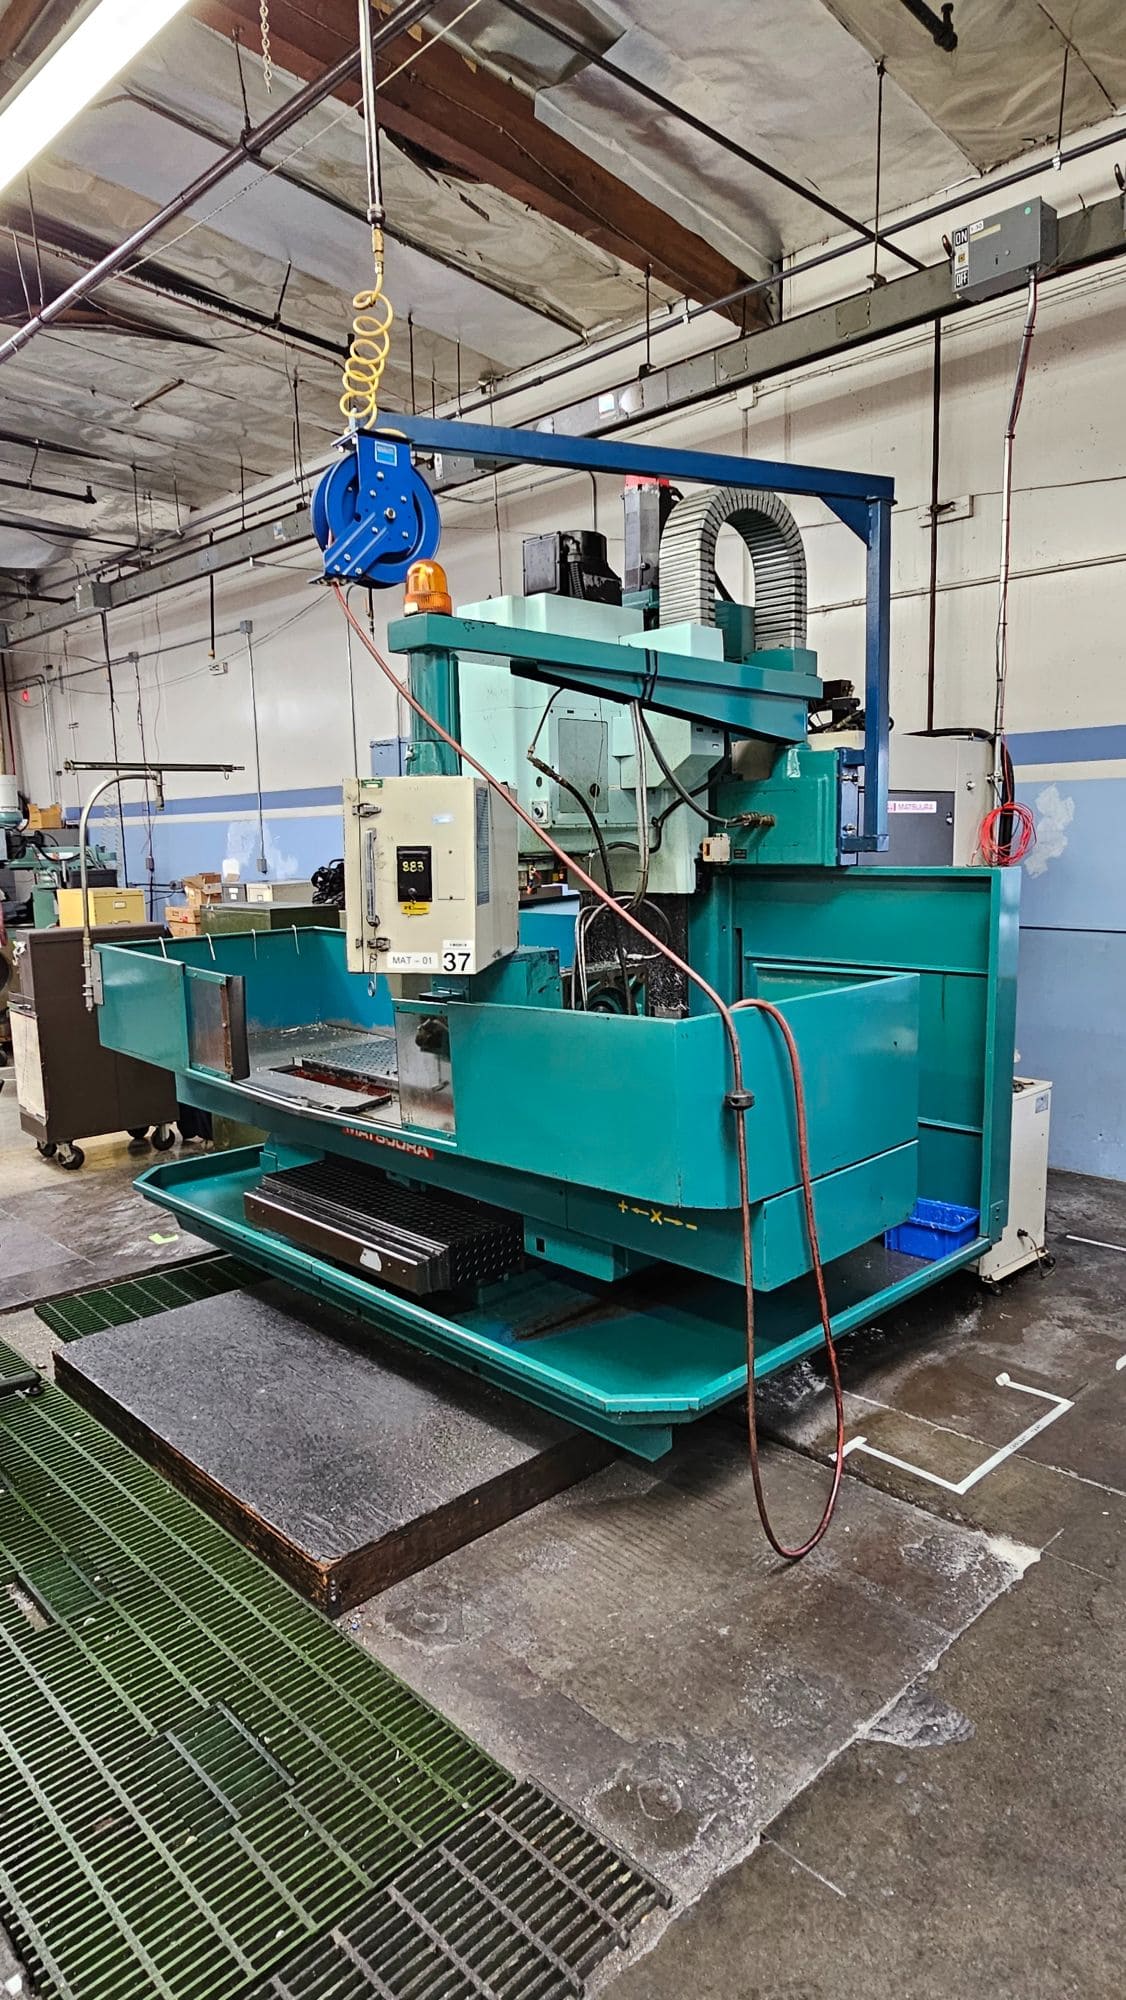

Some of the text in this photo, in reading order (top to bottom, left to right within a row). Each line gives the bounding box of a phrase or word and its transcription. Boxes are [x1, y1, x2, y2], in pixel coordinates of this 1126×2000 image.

[955, 229, 968, 245] ON
[956, 271, 968, 287] OFF
[392, 956, 412, 965] MAT
[422, 956, 432, 965] 01
[443, 952, 471, 972] 37
[650, 1208, 663, 1225] X
